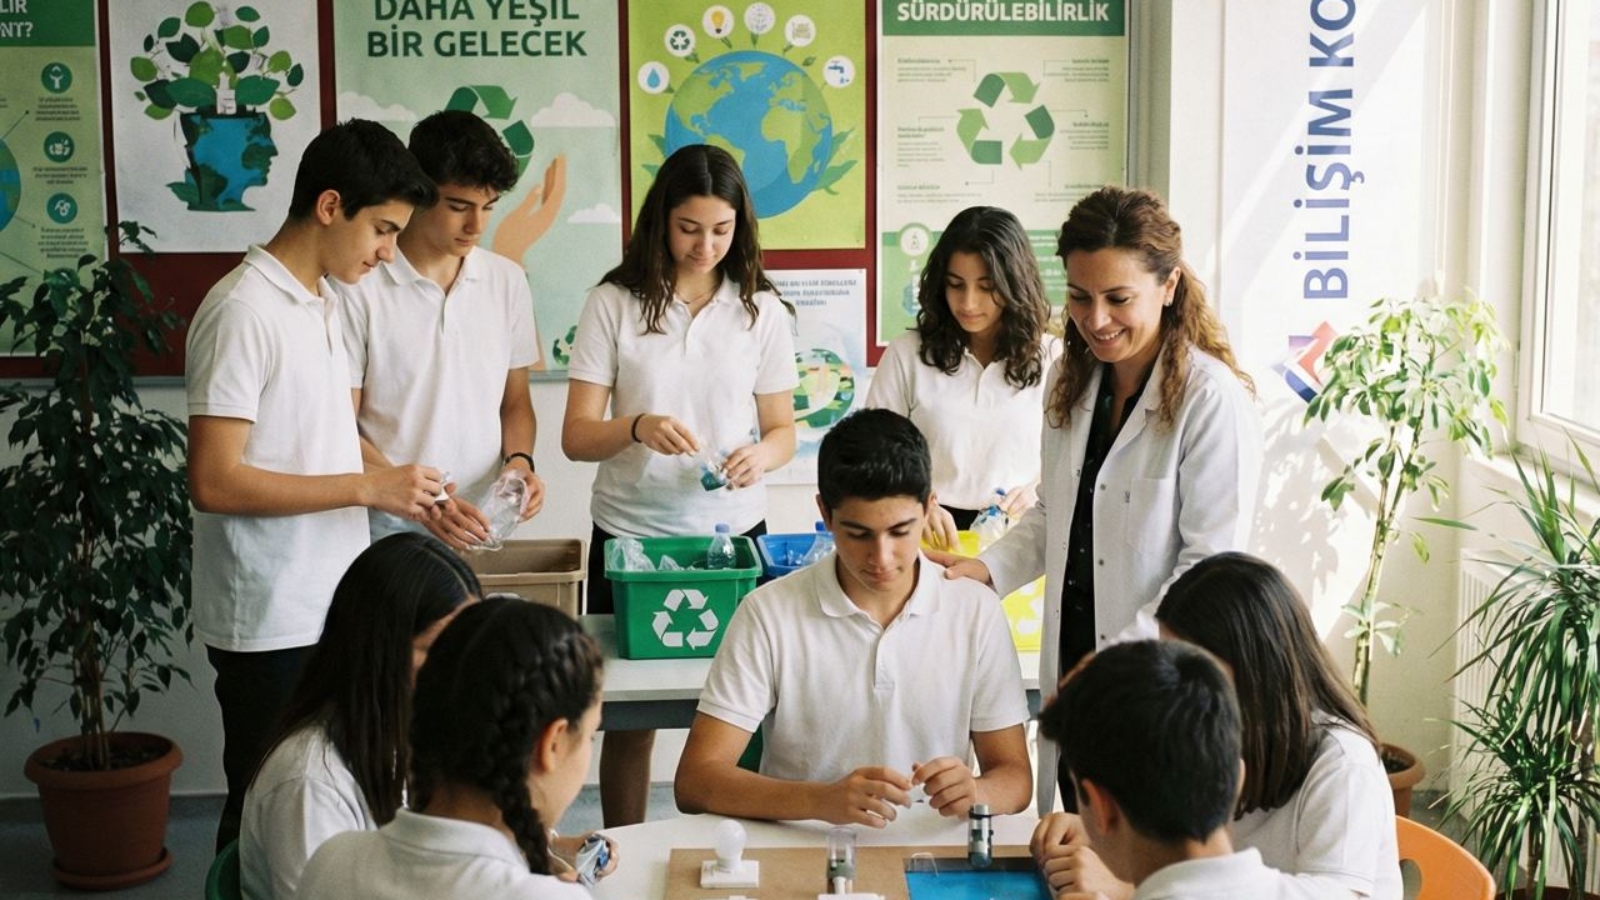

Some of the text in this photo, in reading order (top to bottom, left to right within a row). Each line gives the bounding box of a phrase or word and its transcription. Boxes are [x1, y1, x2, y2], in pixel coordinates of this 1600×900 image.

[375, 0, 474, 20] DAHA
[897, 0, 1109, 21] SÜRDÜRÜLEBİLİRLİK
[367, 24, 587, 57] BİR GELECEK
[1293, 89, 1364, 299] BİLİŞİM
